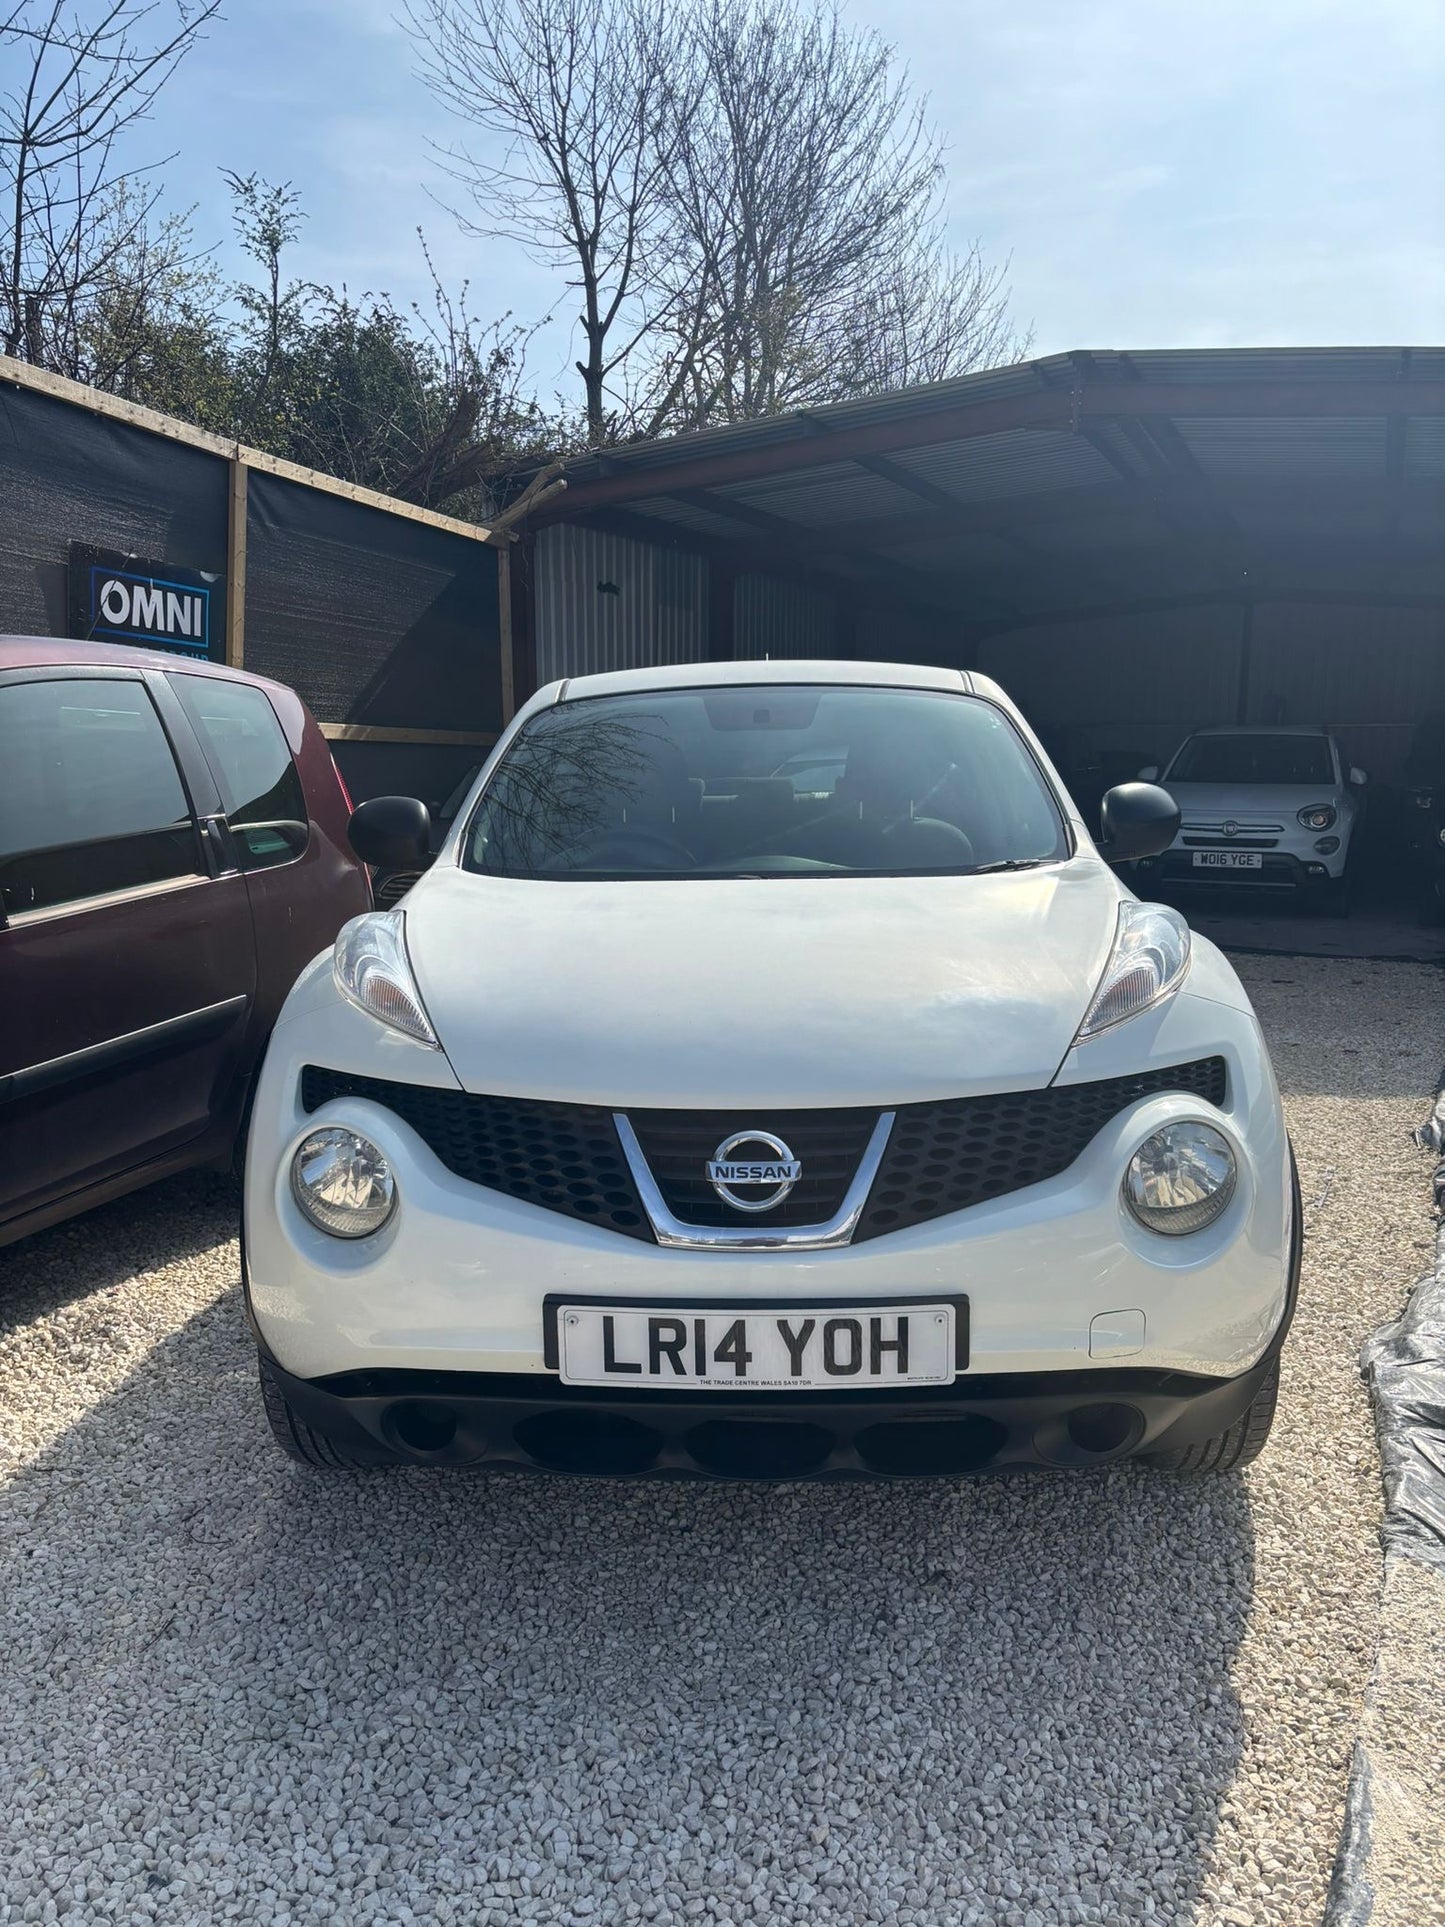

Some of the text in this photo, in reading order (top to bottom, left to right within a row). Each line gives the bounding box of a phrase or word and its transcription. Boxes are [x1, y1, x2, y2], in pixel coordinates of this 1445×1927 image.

[101, 580, 202, 637] OMNI
[1231, 854, 1255, 866] YGE
[715, 1166, 791, 1179] NISSAN
[603, 1316, 909, 1377] LR14 YOH
